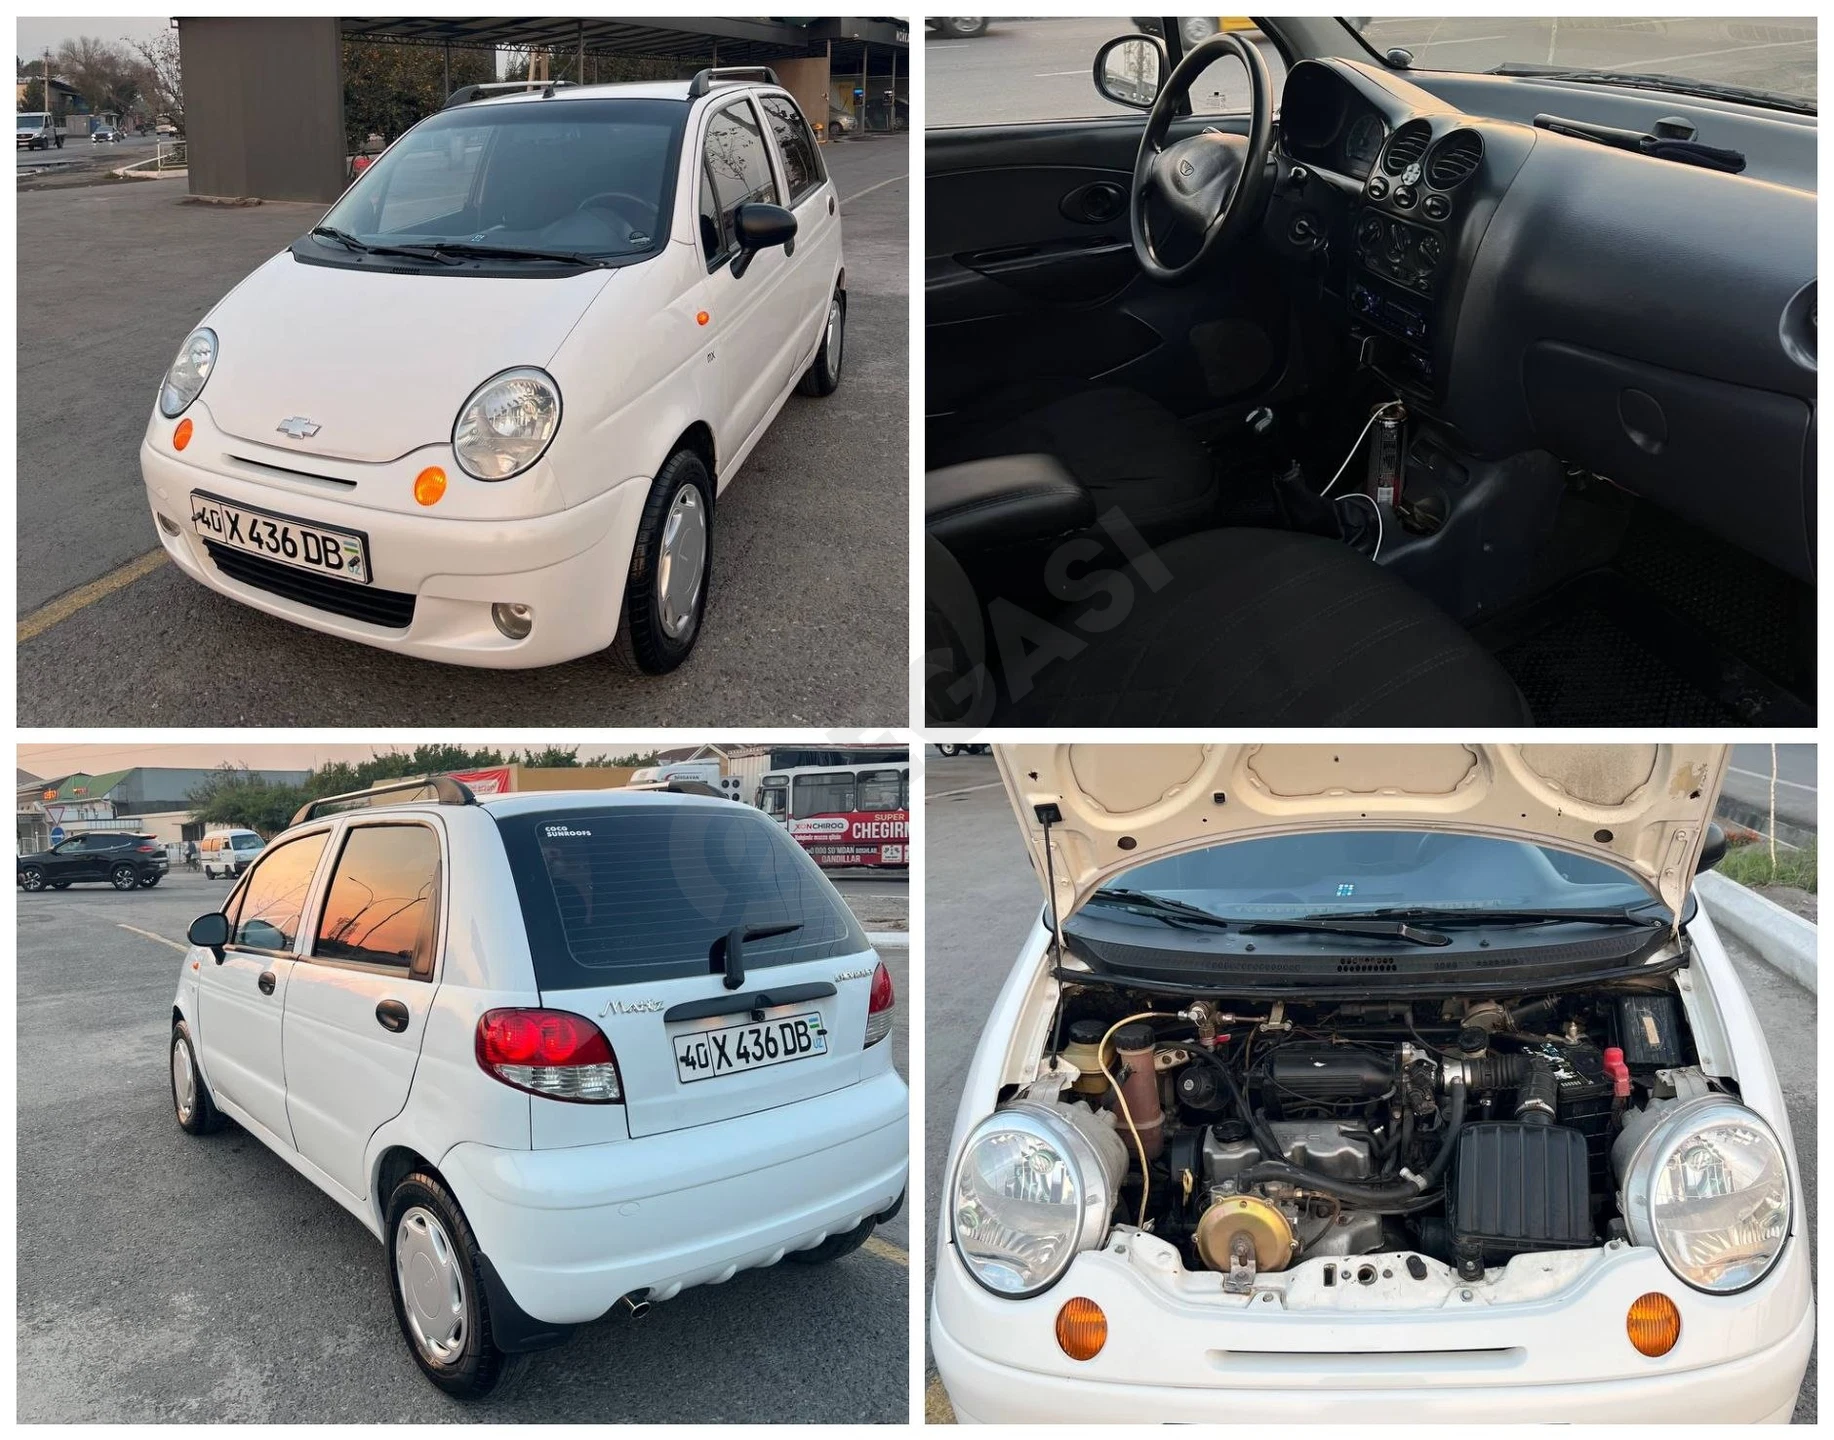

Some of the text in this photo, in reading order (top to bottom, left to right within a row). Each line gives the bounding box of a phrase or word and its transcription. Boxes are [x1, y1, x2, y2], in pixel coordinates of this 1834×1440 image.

[200, 507, 344, 570] 40 X 436 DB
[873, 813, 905, 822] SUPER
[682, 1020, 812, 1070] 40 X 436 DB
[812, 1036, 824, 1049] UZ
